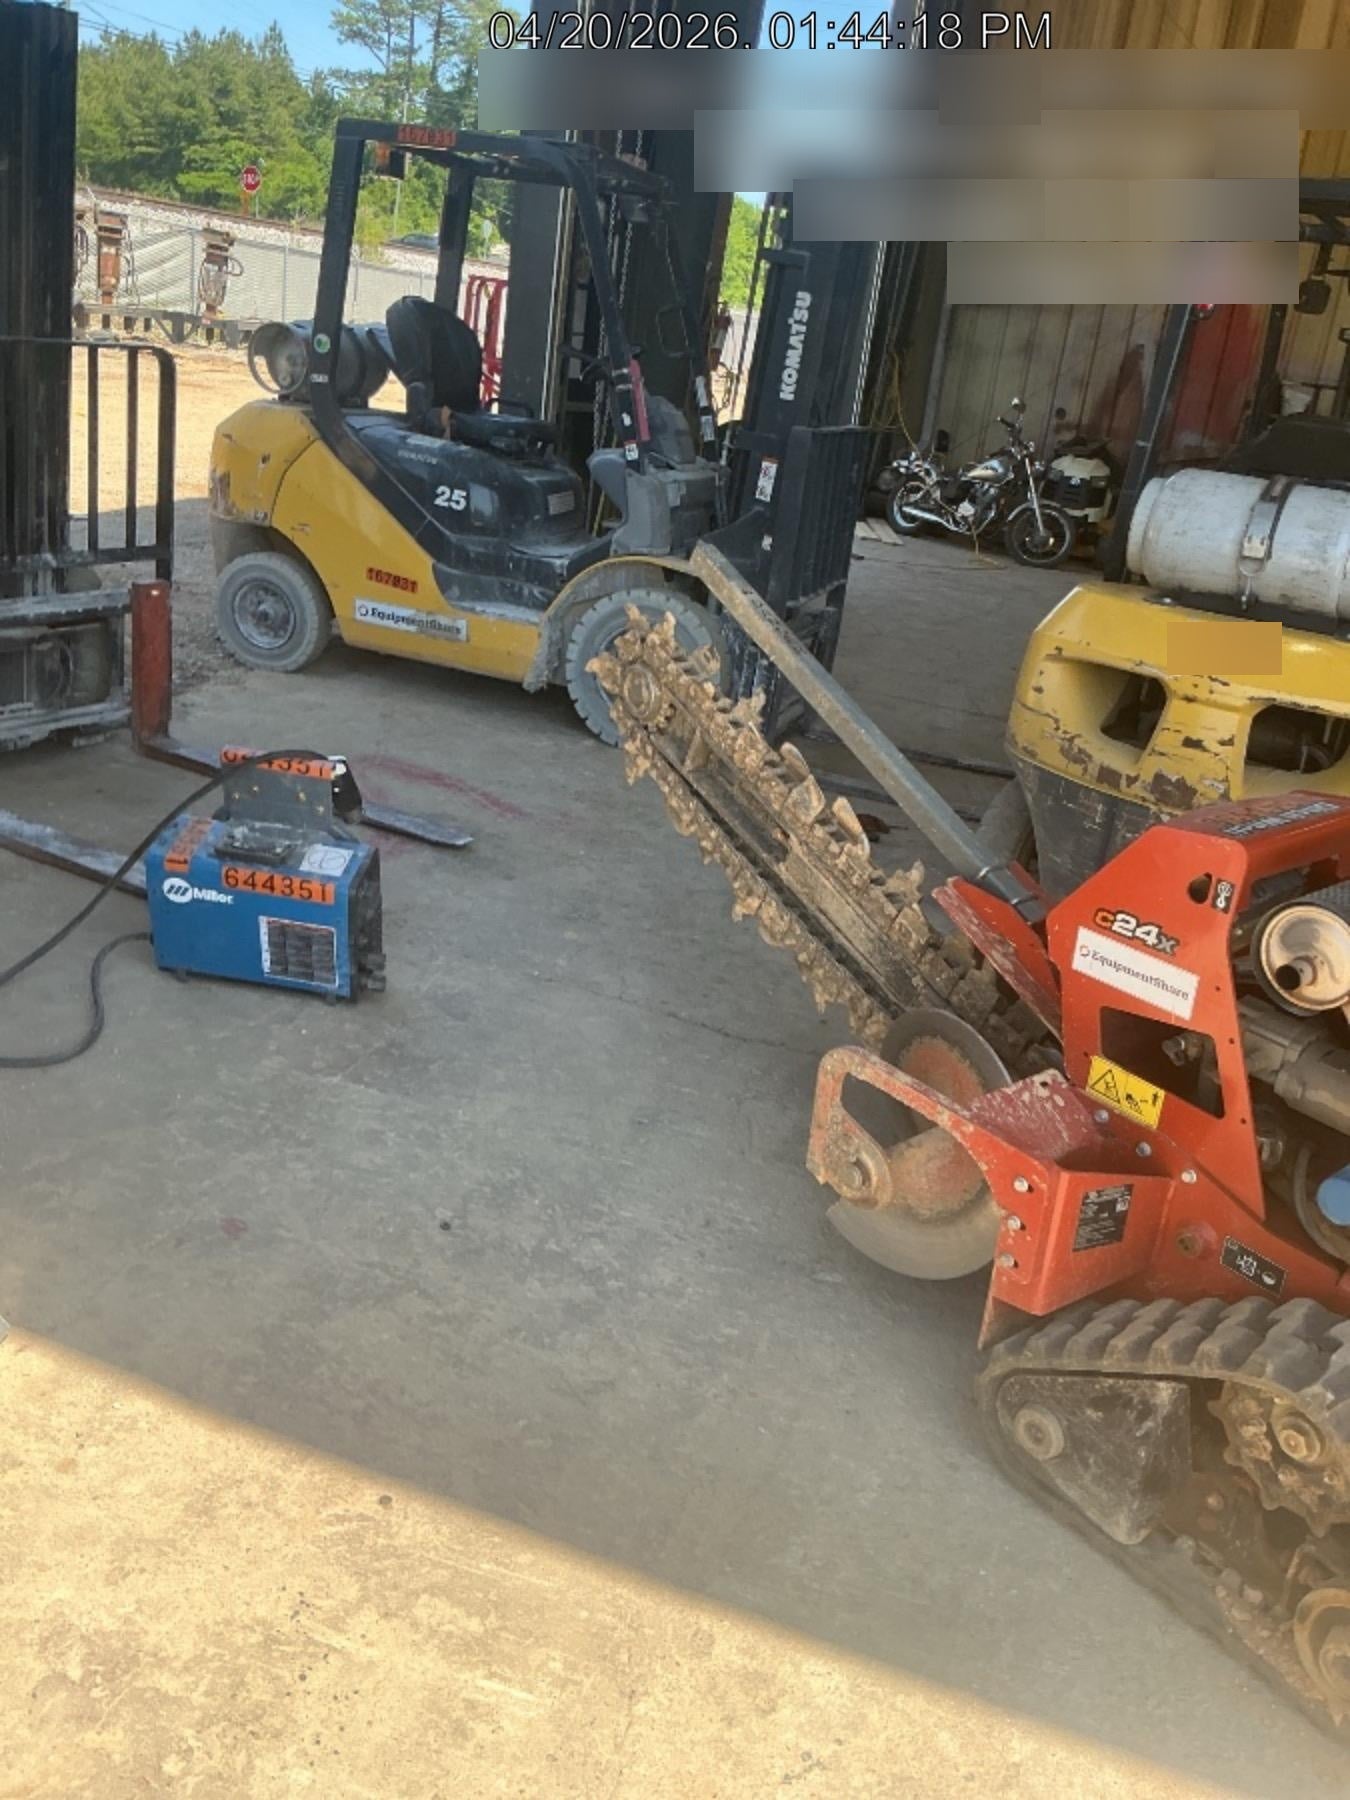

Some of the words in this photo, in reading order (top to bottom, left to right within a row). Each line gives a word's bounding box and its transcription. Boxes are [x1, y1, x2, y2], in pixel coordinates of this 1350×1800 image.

[779, 290, 812, 401] KOMATSU
[434, 485, 467, 511] 25
[193, 887, 234, 904] Miller
[224, 867, 328, 902] 644351
[1090, 950, 1189, 1001] EquipmentShare
